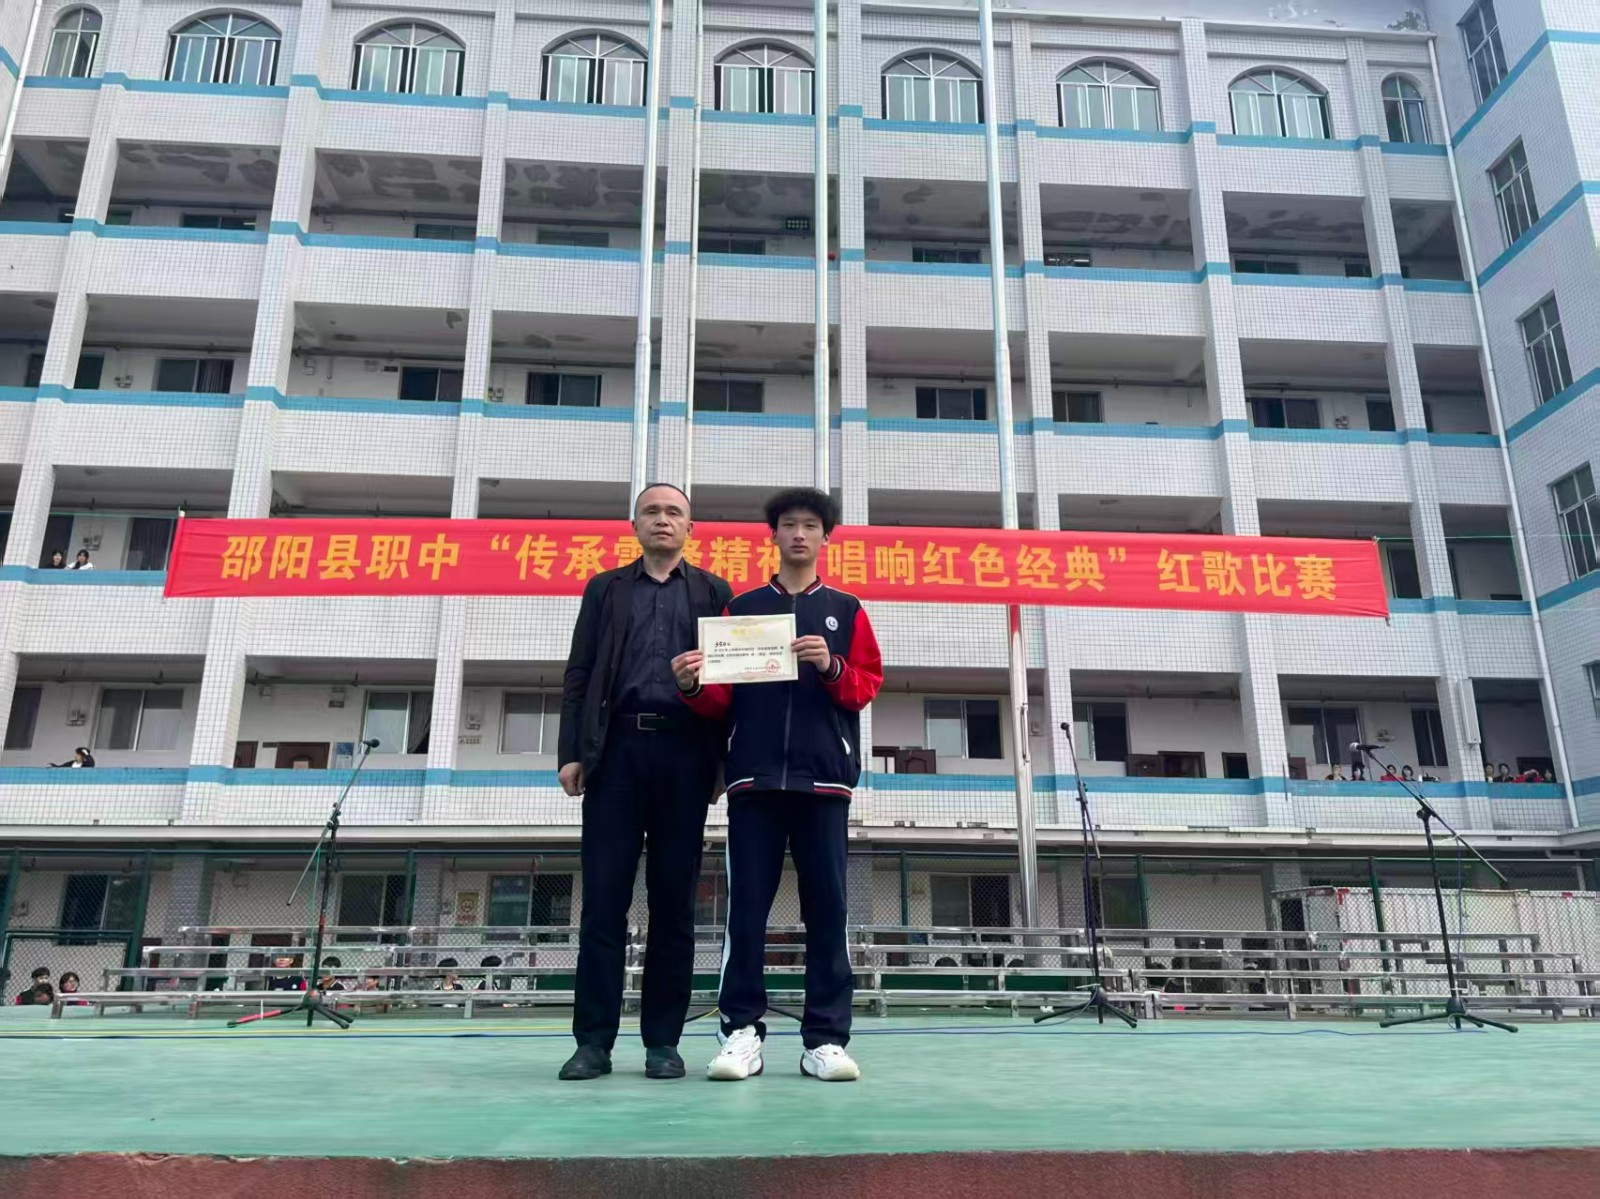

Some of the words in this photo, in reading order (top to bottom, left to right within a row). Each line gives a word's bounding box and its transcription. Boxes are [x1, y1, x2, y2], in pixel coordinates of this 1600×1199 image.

[221, 533, 460, 581] 邵阳县职中
[827, 540, 1127, 591] 唱响红色经典”
[1158, 550, 1337, 600] 红歌比赛
